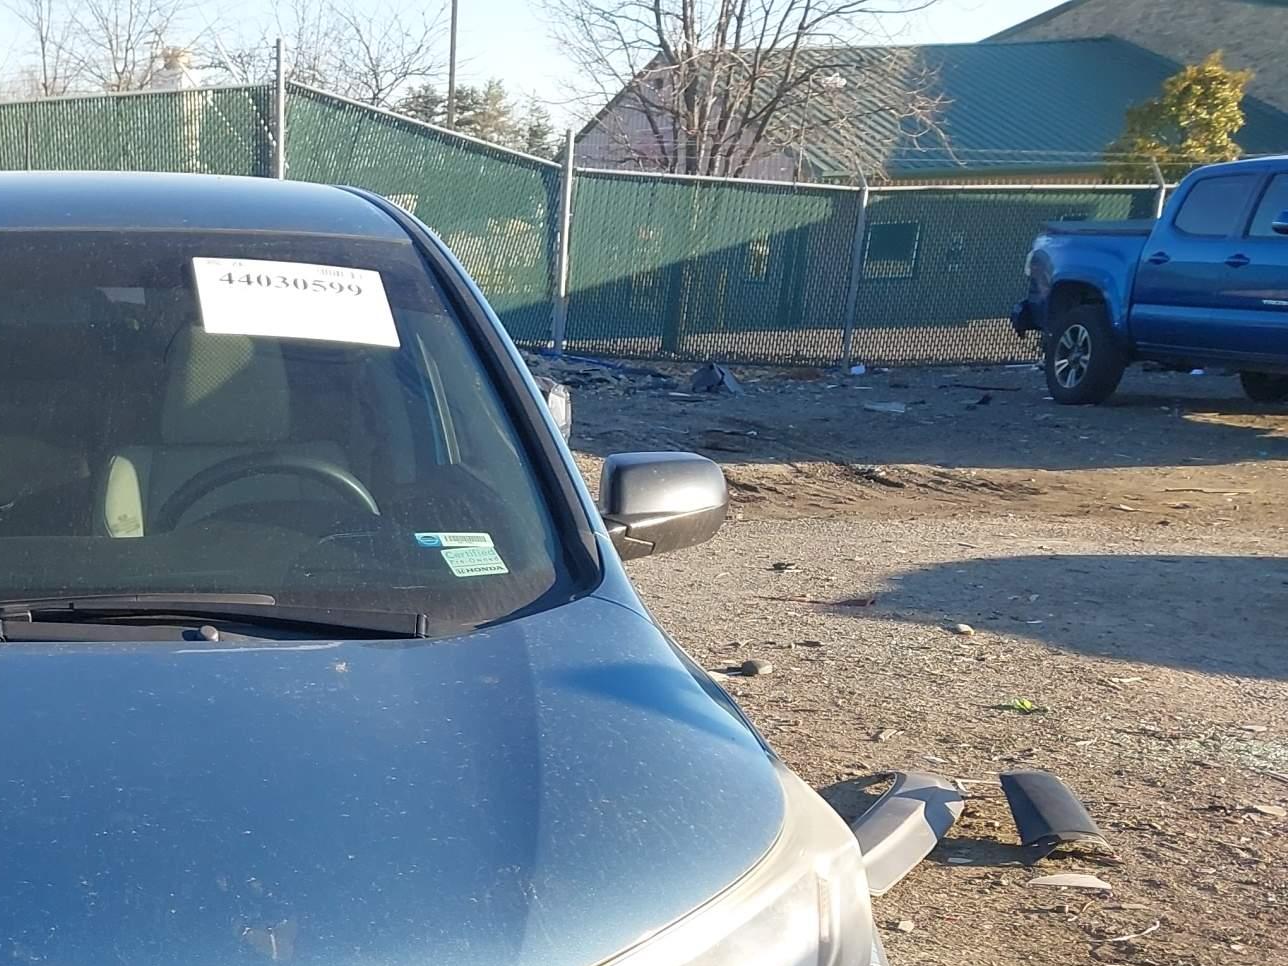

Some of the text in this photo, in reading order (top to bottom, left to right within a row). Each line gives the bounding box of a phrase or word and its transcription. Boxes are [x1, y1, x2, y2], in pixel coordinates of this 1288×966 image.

[218, 272, 363, 297] 44030599
[445, 547, 496, 559] Certified
[466, 565, 505, 574] HONDA
